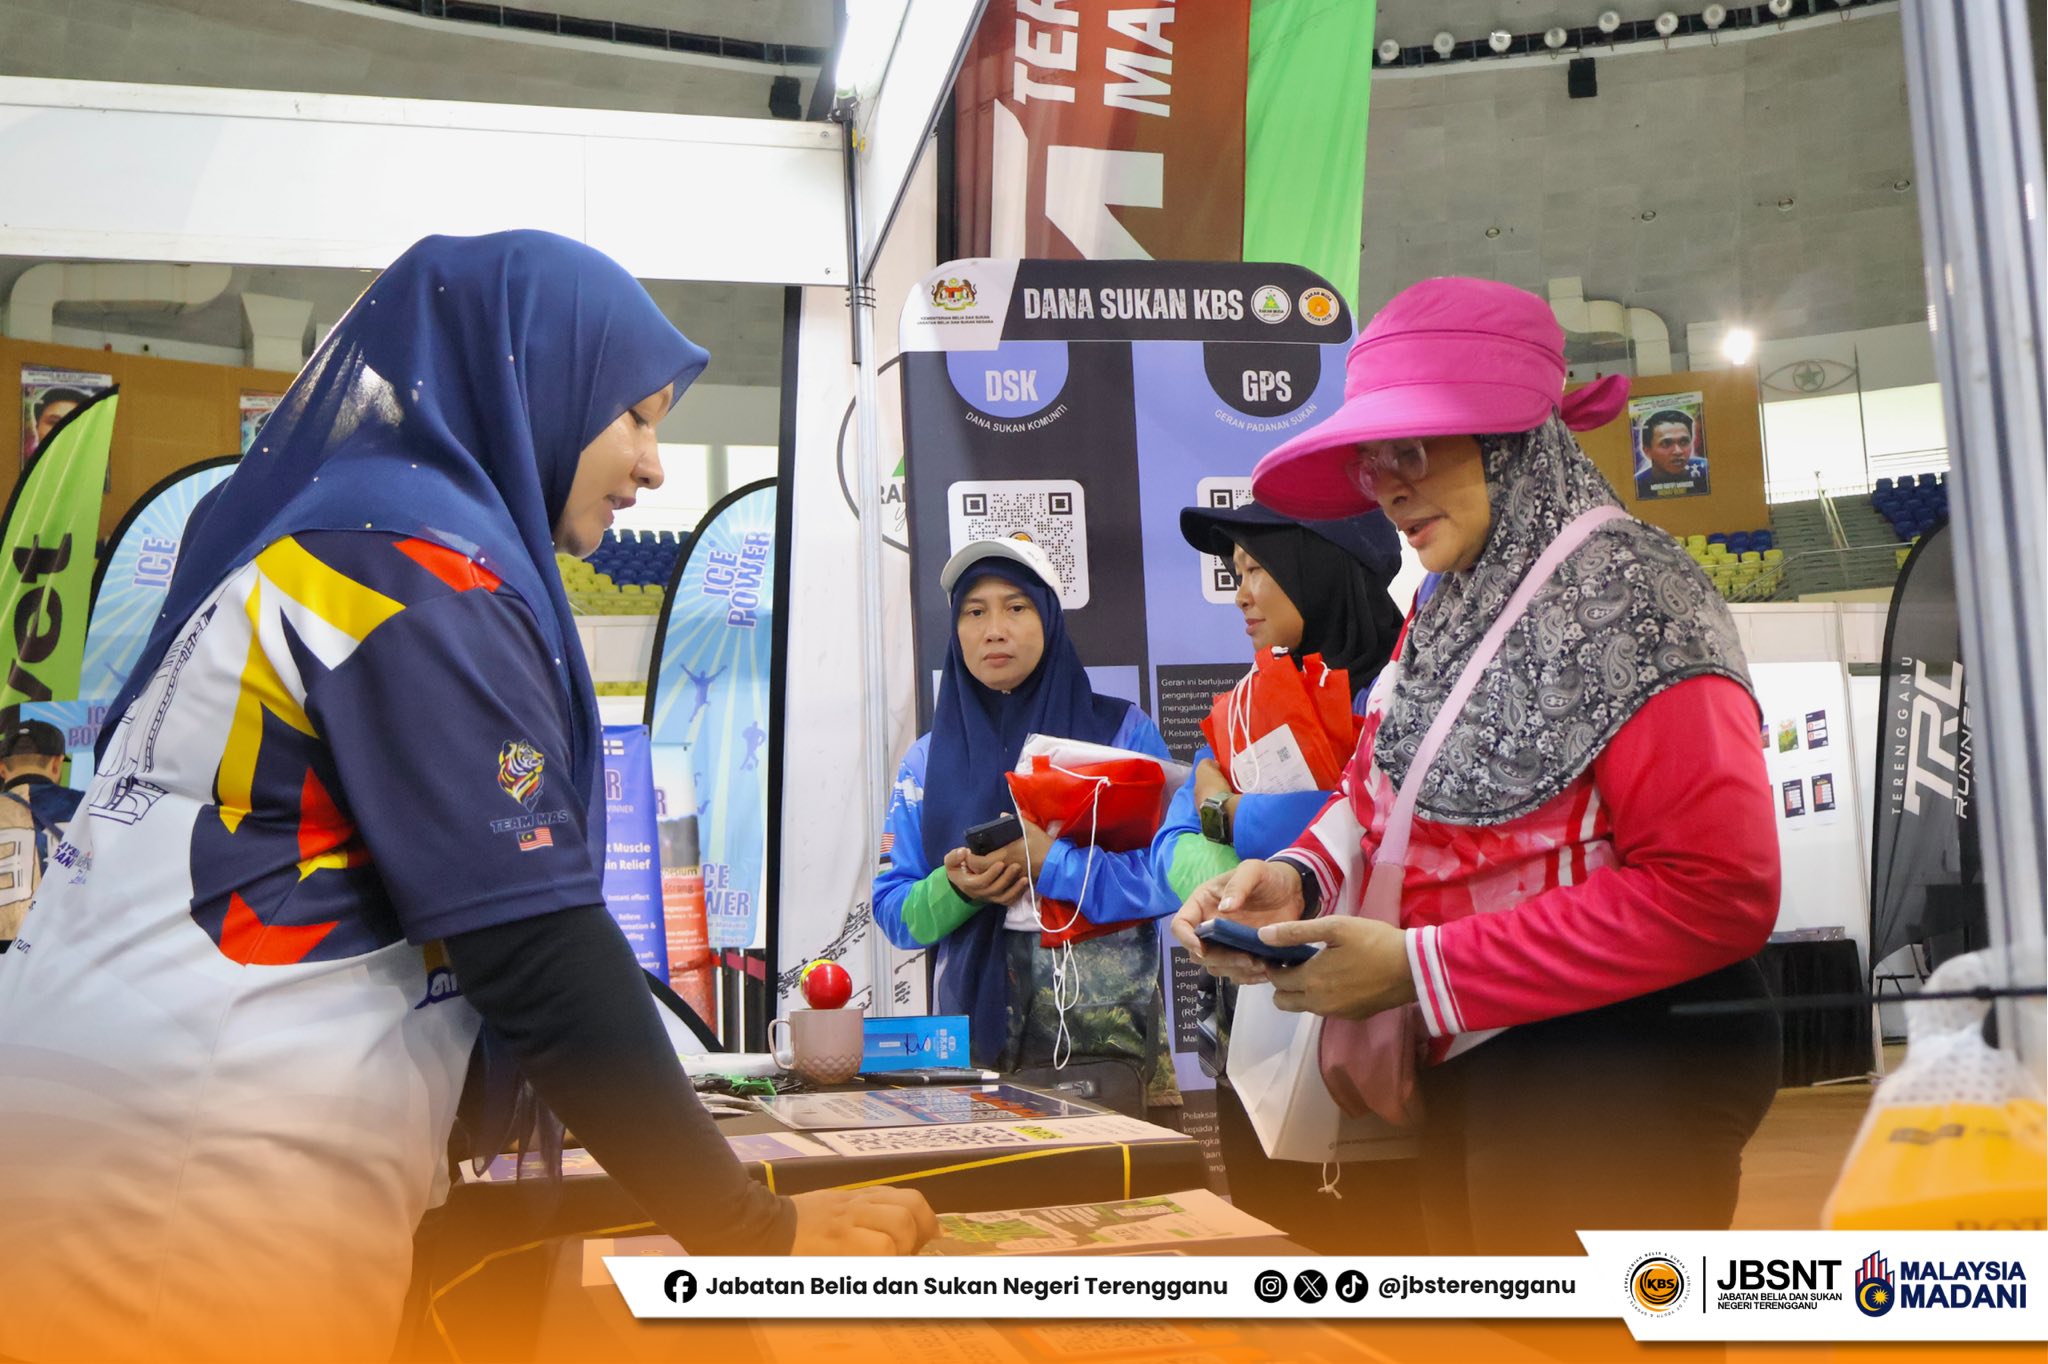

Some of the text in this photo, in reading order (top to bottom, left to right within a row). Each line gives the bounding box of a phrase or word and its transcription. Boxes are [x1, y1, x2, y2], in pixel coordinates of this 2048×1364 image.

[1103, 0, 1176, 117] MA
[1023, 288, 1244, 321] DANA SUKAN KBS
[984, 369, 1039, 402] DSK
[1242, 369, 1292, 402] GPS
[965, 403, 1068, 433] DANA SUKAN KOMUNITI
[1214, 403, 1319, 433] GERAN PADANAN SUKAN
[133, 536, 179, 590] ICE
[703, 549, 739, 598] ICE
[726, 531, 771, 628] POWER
[1161, 678, 1186, 687] Geran
[1187, 678, 1196, 686] ini
[1198, 677, 1234, 687] bertujuan
[1162, 692, 1210, 701] penganjuran
[1891, 656, 1913, 815] TERENGGANU
[490, 809, 569, 834] TEAM MAS
[612, 841, 651, 855] Muscle
[619, 858, 652, 871] Relief
